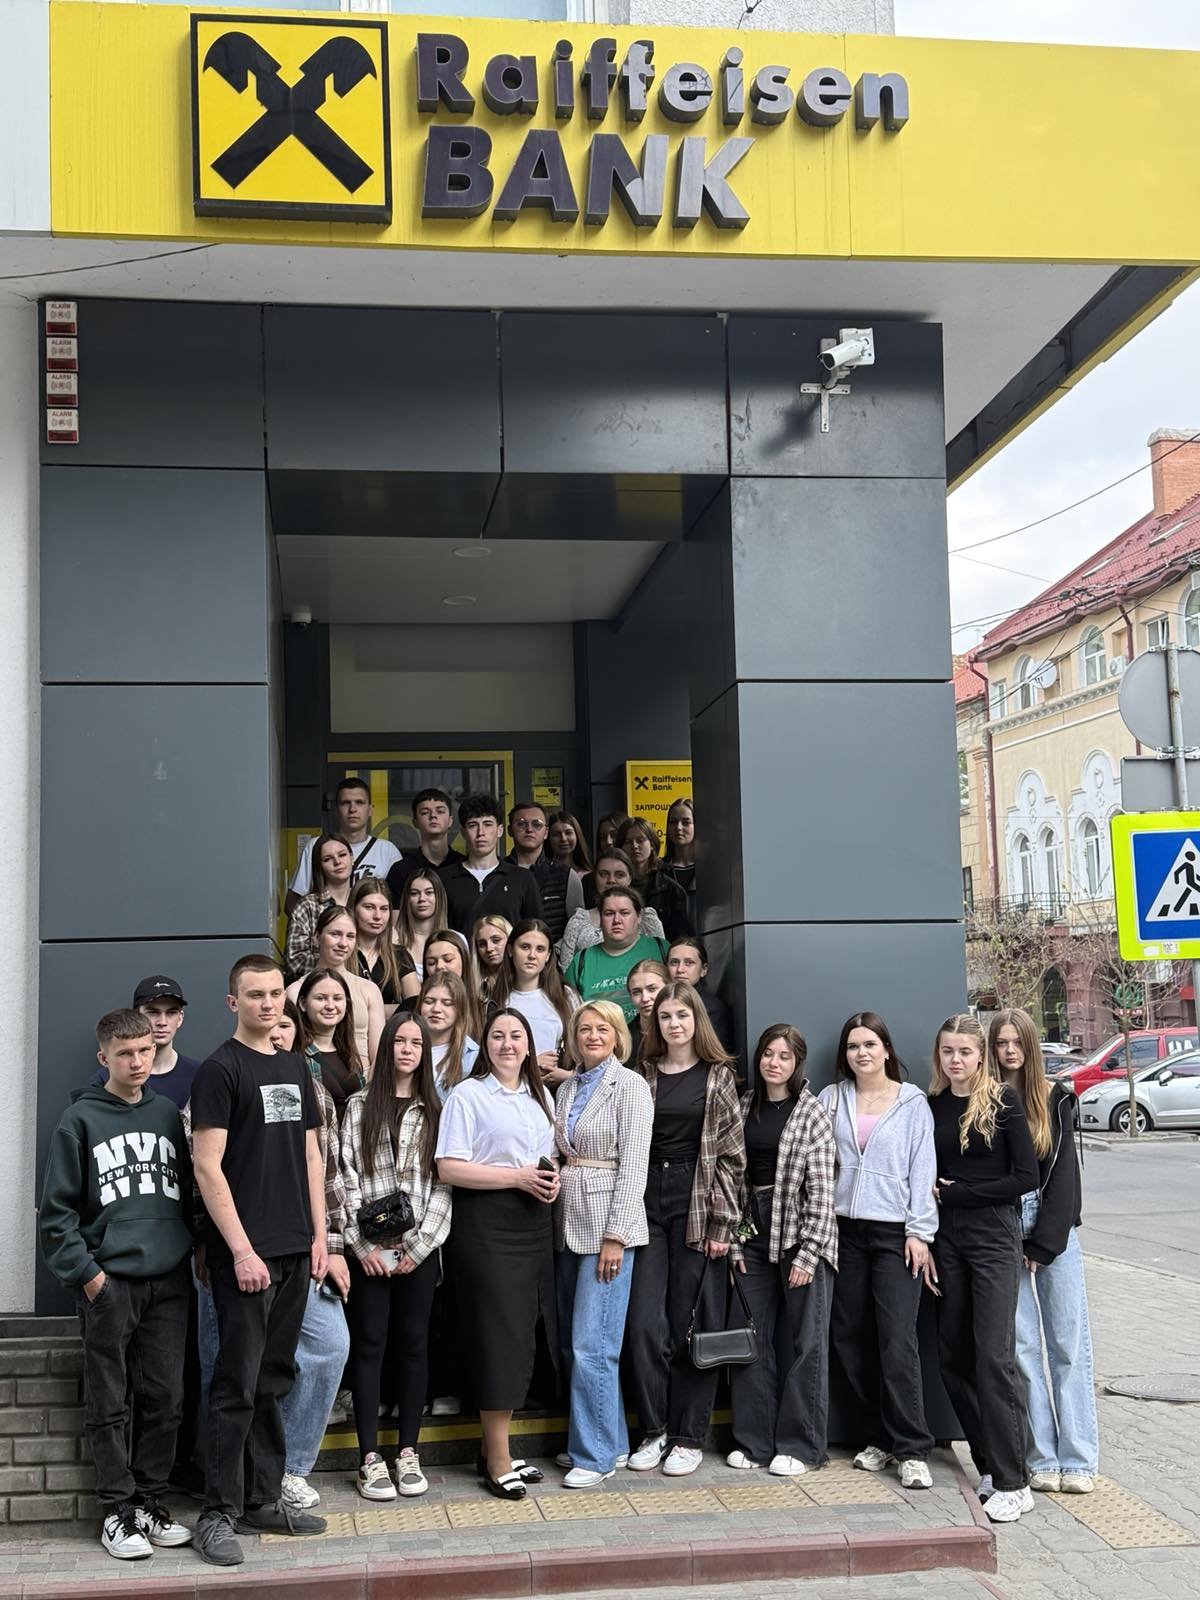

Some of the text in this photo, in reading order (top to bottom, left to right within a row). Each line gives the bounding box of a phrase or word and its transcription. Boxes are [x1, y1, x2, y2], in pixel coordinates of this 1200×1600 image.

[416, 32, 910, 131] Raiffeisen
[422, 124, 756, 229] BANK
[652, 775, 692, 783] Raiffeisen
[652, 783, 673, 791] Bank
[98, 1163, 179, 1186] NEW YORK CITY
